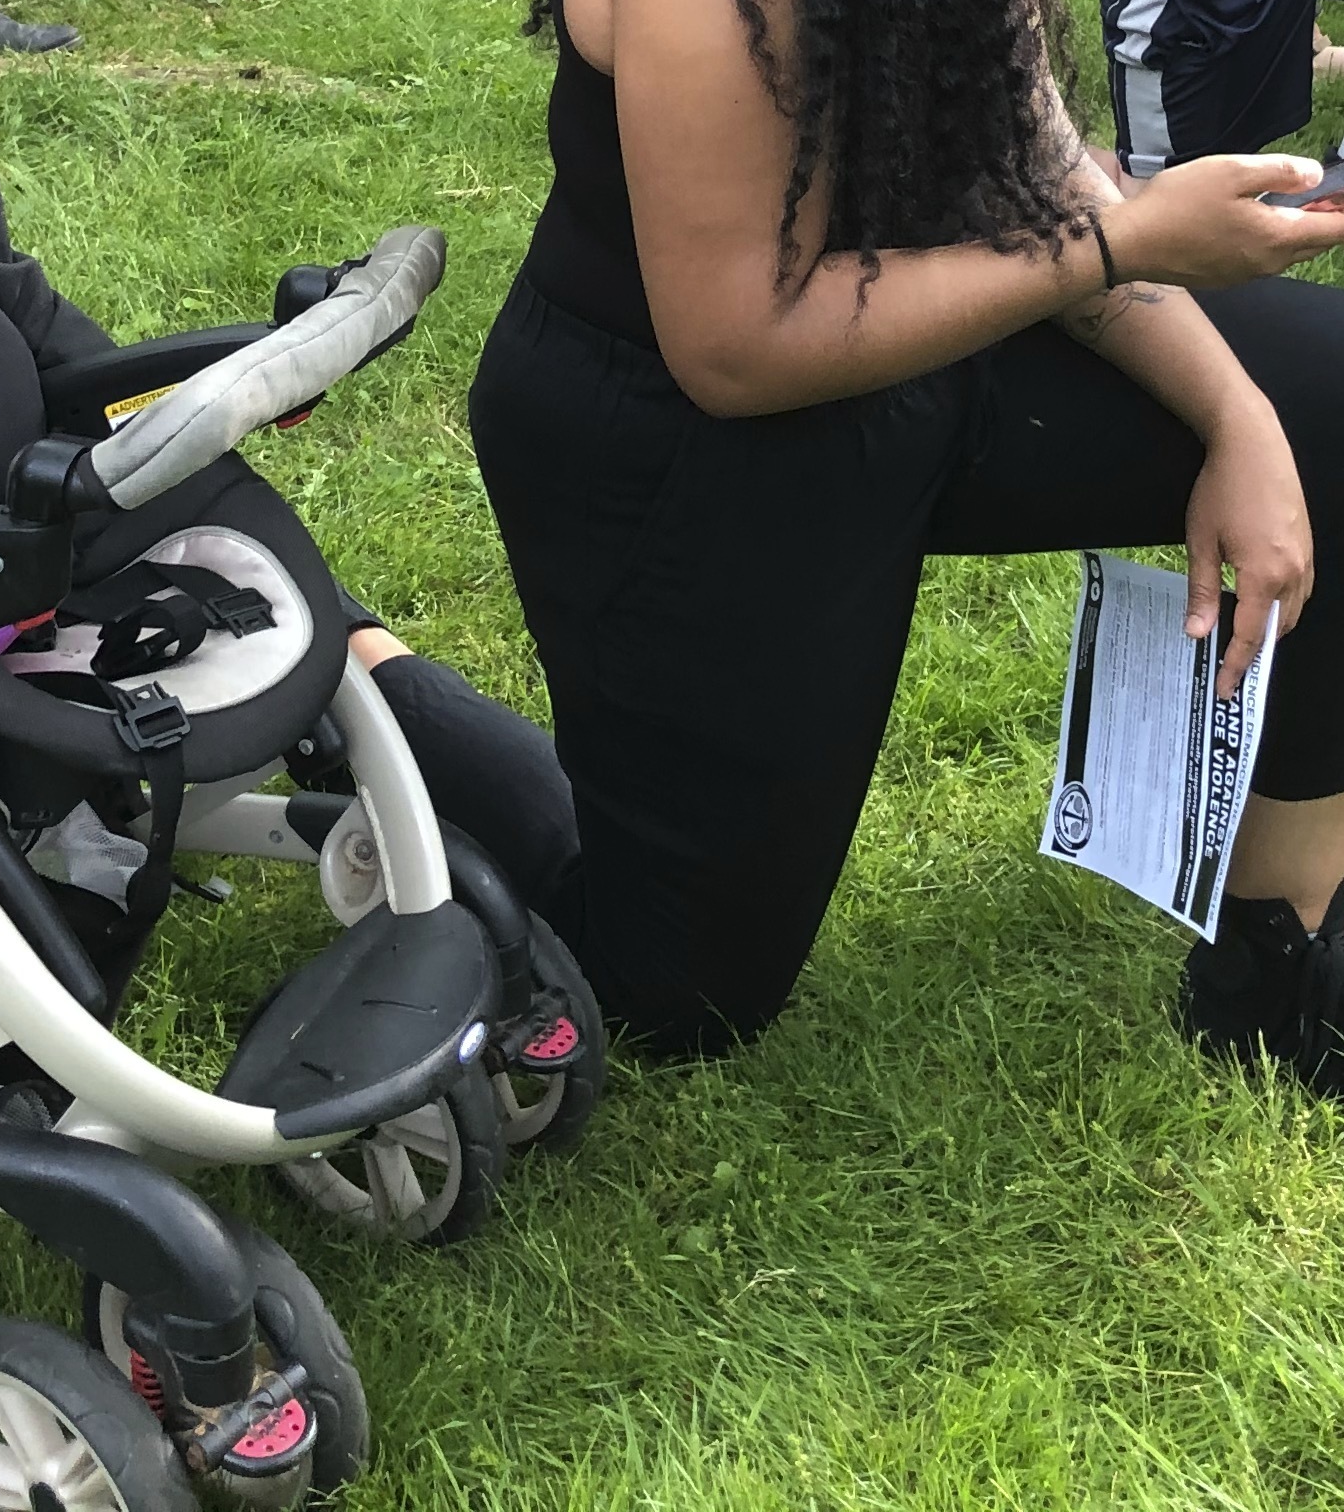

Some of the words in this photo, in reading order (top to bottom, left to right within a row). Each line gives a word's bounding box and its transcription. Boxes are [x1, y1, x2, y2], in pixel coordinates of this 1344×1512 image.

[1227, 688, 1240, 749] TAND
[1246, 650, 1262, 719] VIDENCE
[1204, 748, 1225, 860] VIOLENCE
[1214, 754, 1237, 856] AGAINST
